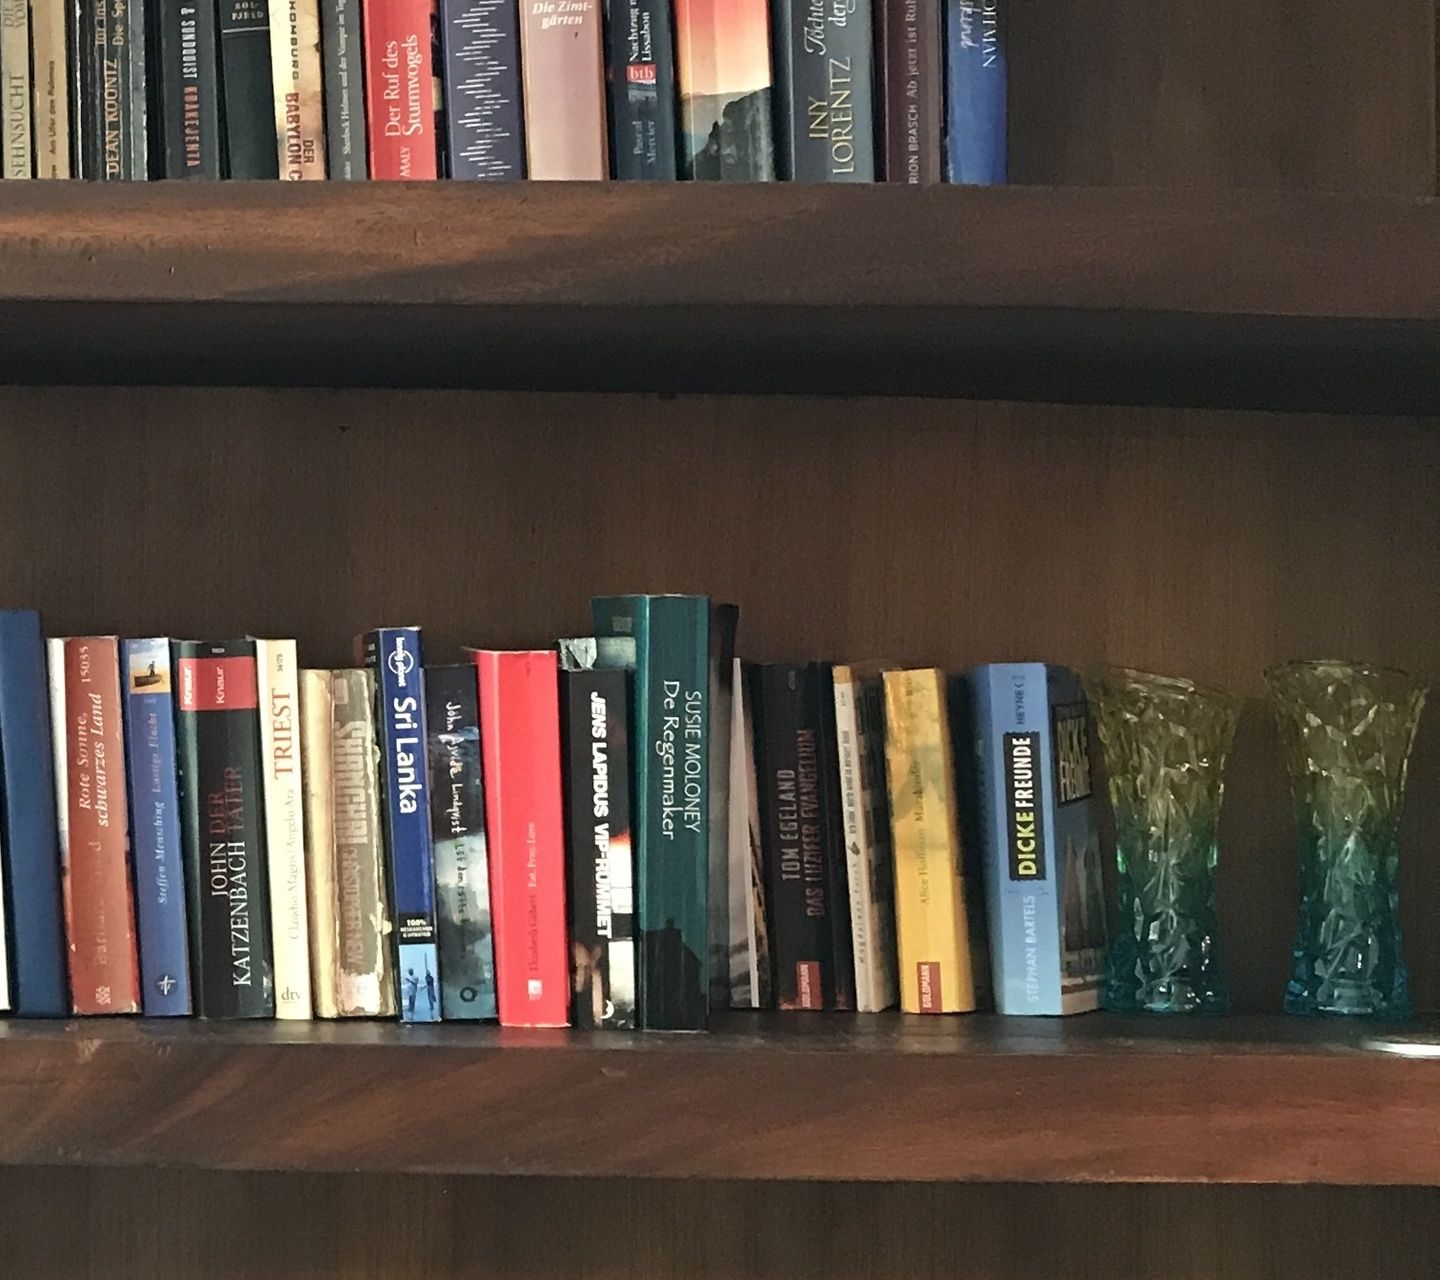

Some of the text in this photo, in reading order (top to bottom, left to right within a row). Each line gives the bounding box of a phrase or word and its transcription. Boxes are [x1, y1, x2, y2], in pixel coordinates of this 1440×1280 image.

[110, 25, 125, 46] Die
[531, 0, 552, 14] Die
[639, 12, 653, 62] Lissabon
[828, 2, 848, 27] der
[8, 72, 26, 178] SEHNSUCHT
[102, 58, 120, 174] DEAN KOONTZ
[284, 92, 303, 166] BABYLON
[382, 40, 402, 137] Der Ruf des
[402, 34, 425, 137] Sturmvogels
[808, 96, 830, 139] INY
[828, 56, 856, 175] LORENTZ
[905, 103, 920, 151] BRASCH
[302, 139, 316, 165] DER
[397, 147, 412, 178] MALY
[88, 693, 109, 828] schwarzes Land
[270, 687, 295, 780] TRIEST
[392, 696, 422, 814] Sri Lanka
[444, 701, 467, 834] John Lindqvist
[654, 680, 681, 841] De Regenmaker
[683, 690, 703, 831] SUSIE MOLONEY
[76, 776, 91, 811] Rote
[590, 692, 613, 938] JENS LAPIDUS VIP-RUMMET
[777, 768, 802, 881] TOM EGELAND
[1011, 737, 1038, 875] DICKE FREUNDE
[210, 842, 228, 897] JOHN
[226, 840, 252, 987] KATZENBACH
[1021, 896, 1040, 1003] STEPHAN BARTELS
